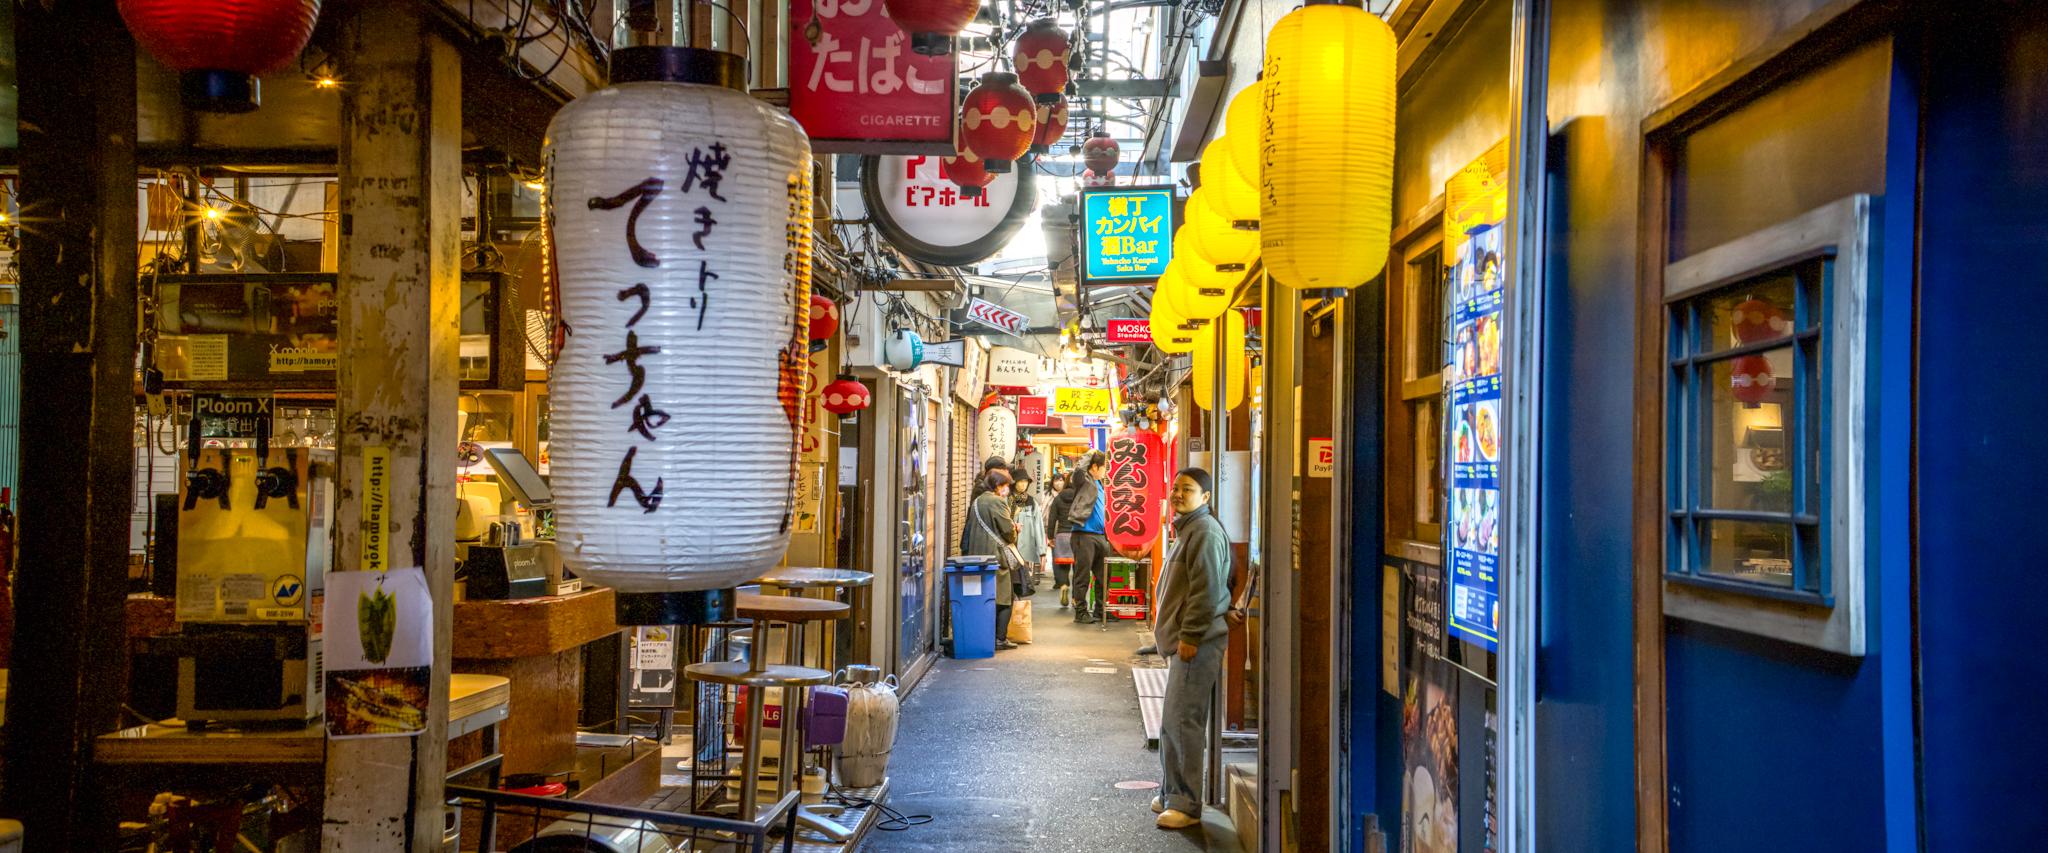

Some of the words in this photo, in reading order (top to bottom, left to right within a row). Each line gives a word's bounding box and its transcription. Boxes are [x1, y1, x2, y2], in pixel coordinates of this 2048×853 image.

[860, 115, 941, 127] CIGARETTE
[906, 186, 990, 207] ビアホール
[1108, 196, 1147, 217] 横丁
[996, 365, 1031, 374] あんちゃん
[197, 398, 253, 413] Ploom
[257, 398, 269, 413] X
[1059, 400, 1106, 412] みんみん
[1110, 438, 1149, 537] みんみん
[367, 456, 384, 569] http://hamoyok
